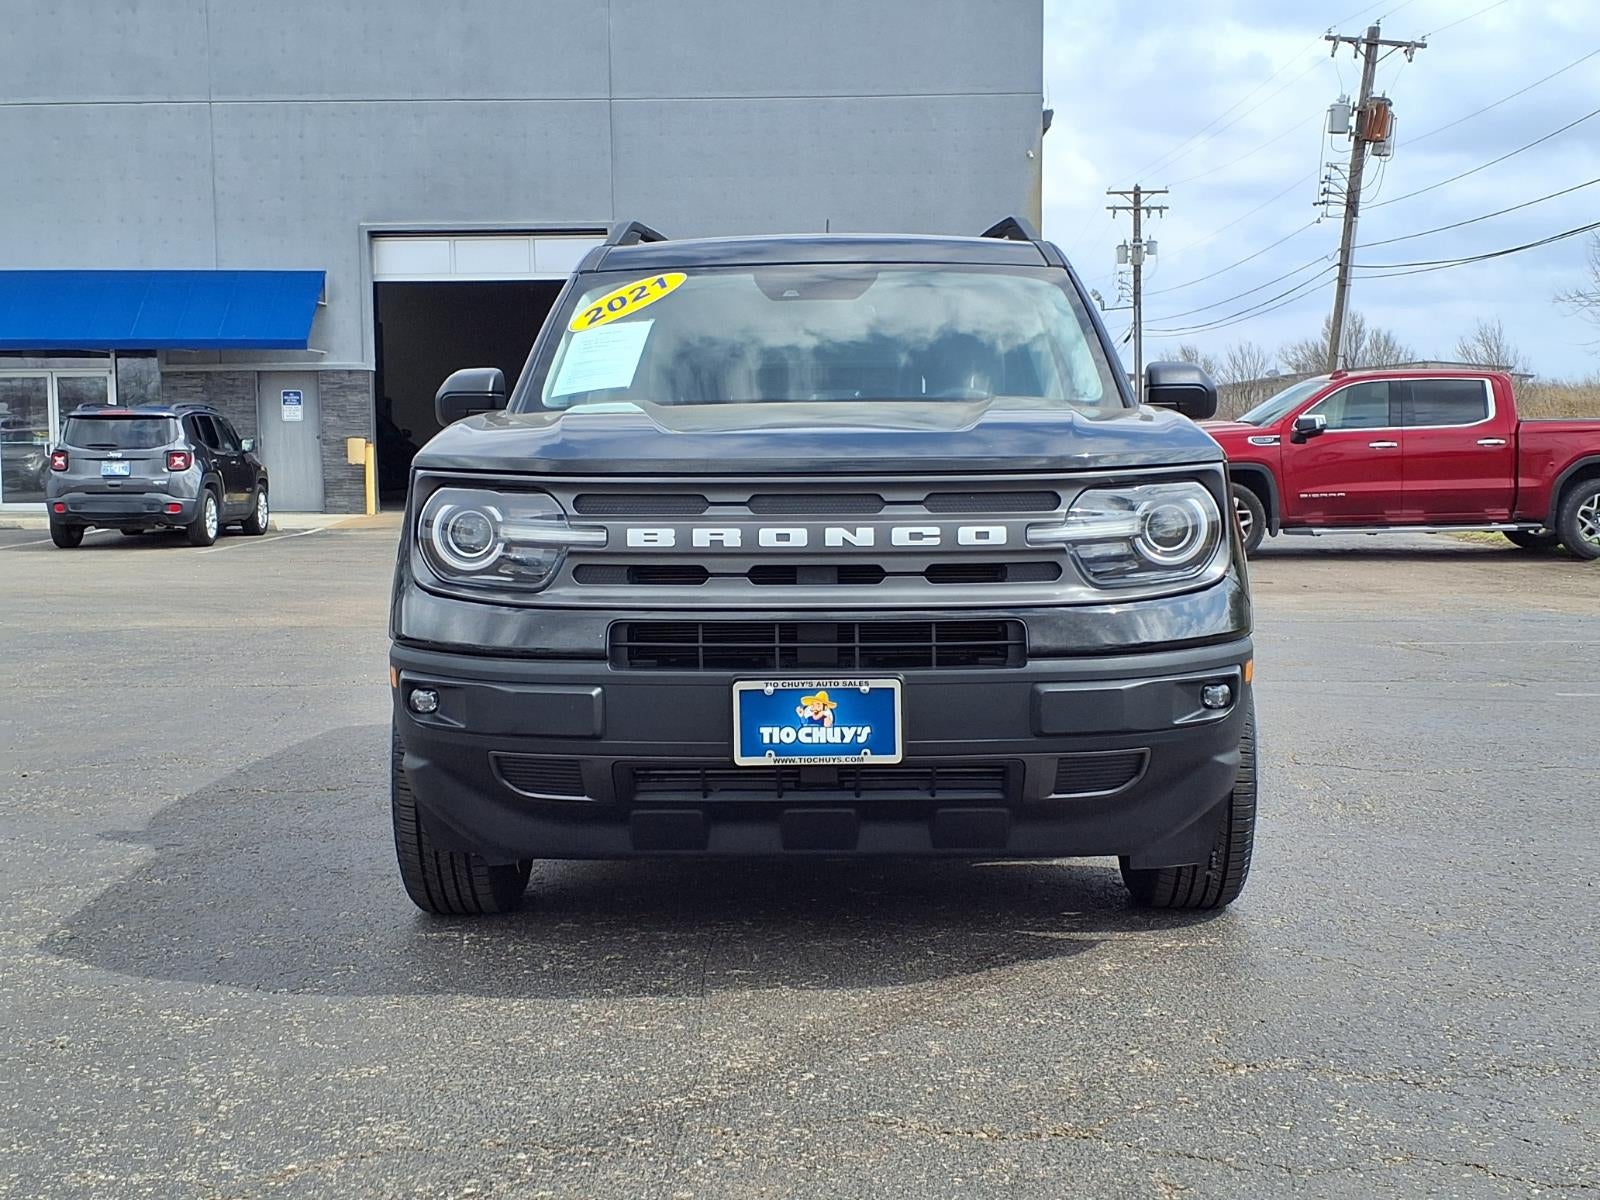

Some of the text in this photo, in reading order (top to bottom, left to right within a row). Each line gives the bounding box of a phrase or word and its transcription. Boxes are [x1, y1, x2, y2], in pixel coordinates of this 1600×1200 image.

[585, 277, 667, 325] 2021
[626, 526, 1008, 548] BRONCO
[773, 756, 864, 764] WWW.TIOCHUYS.COM
